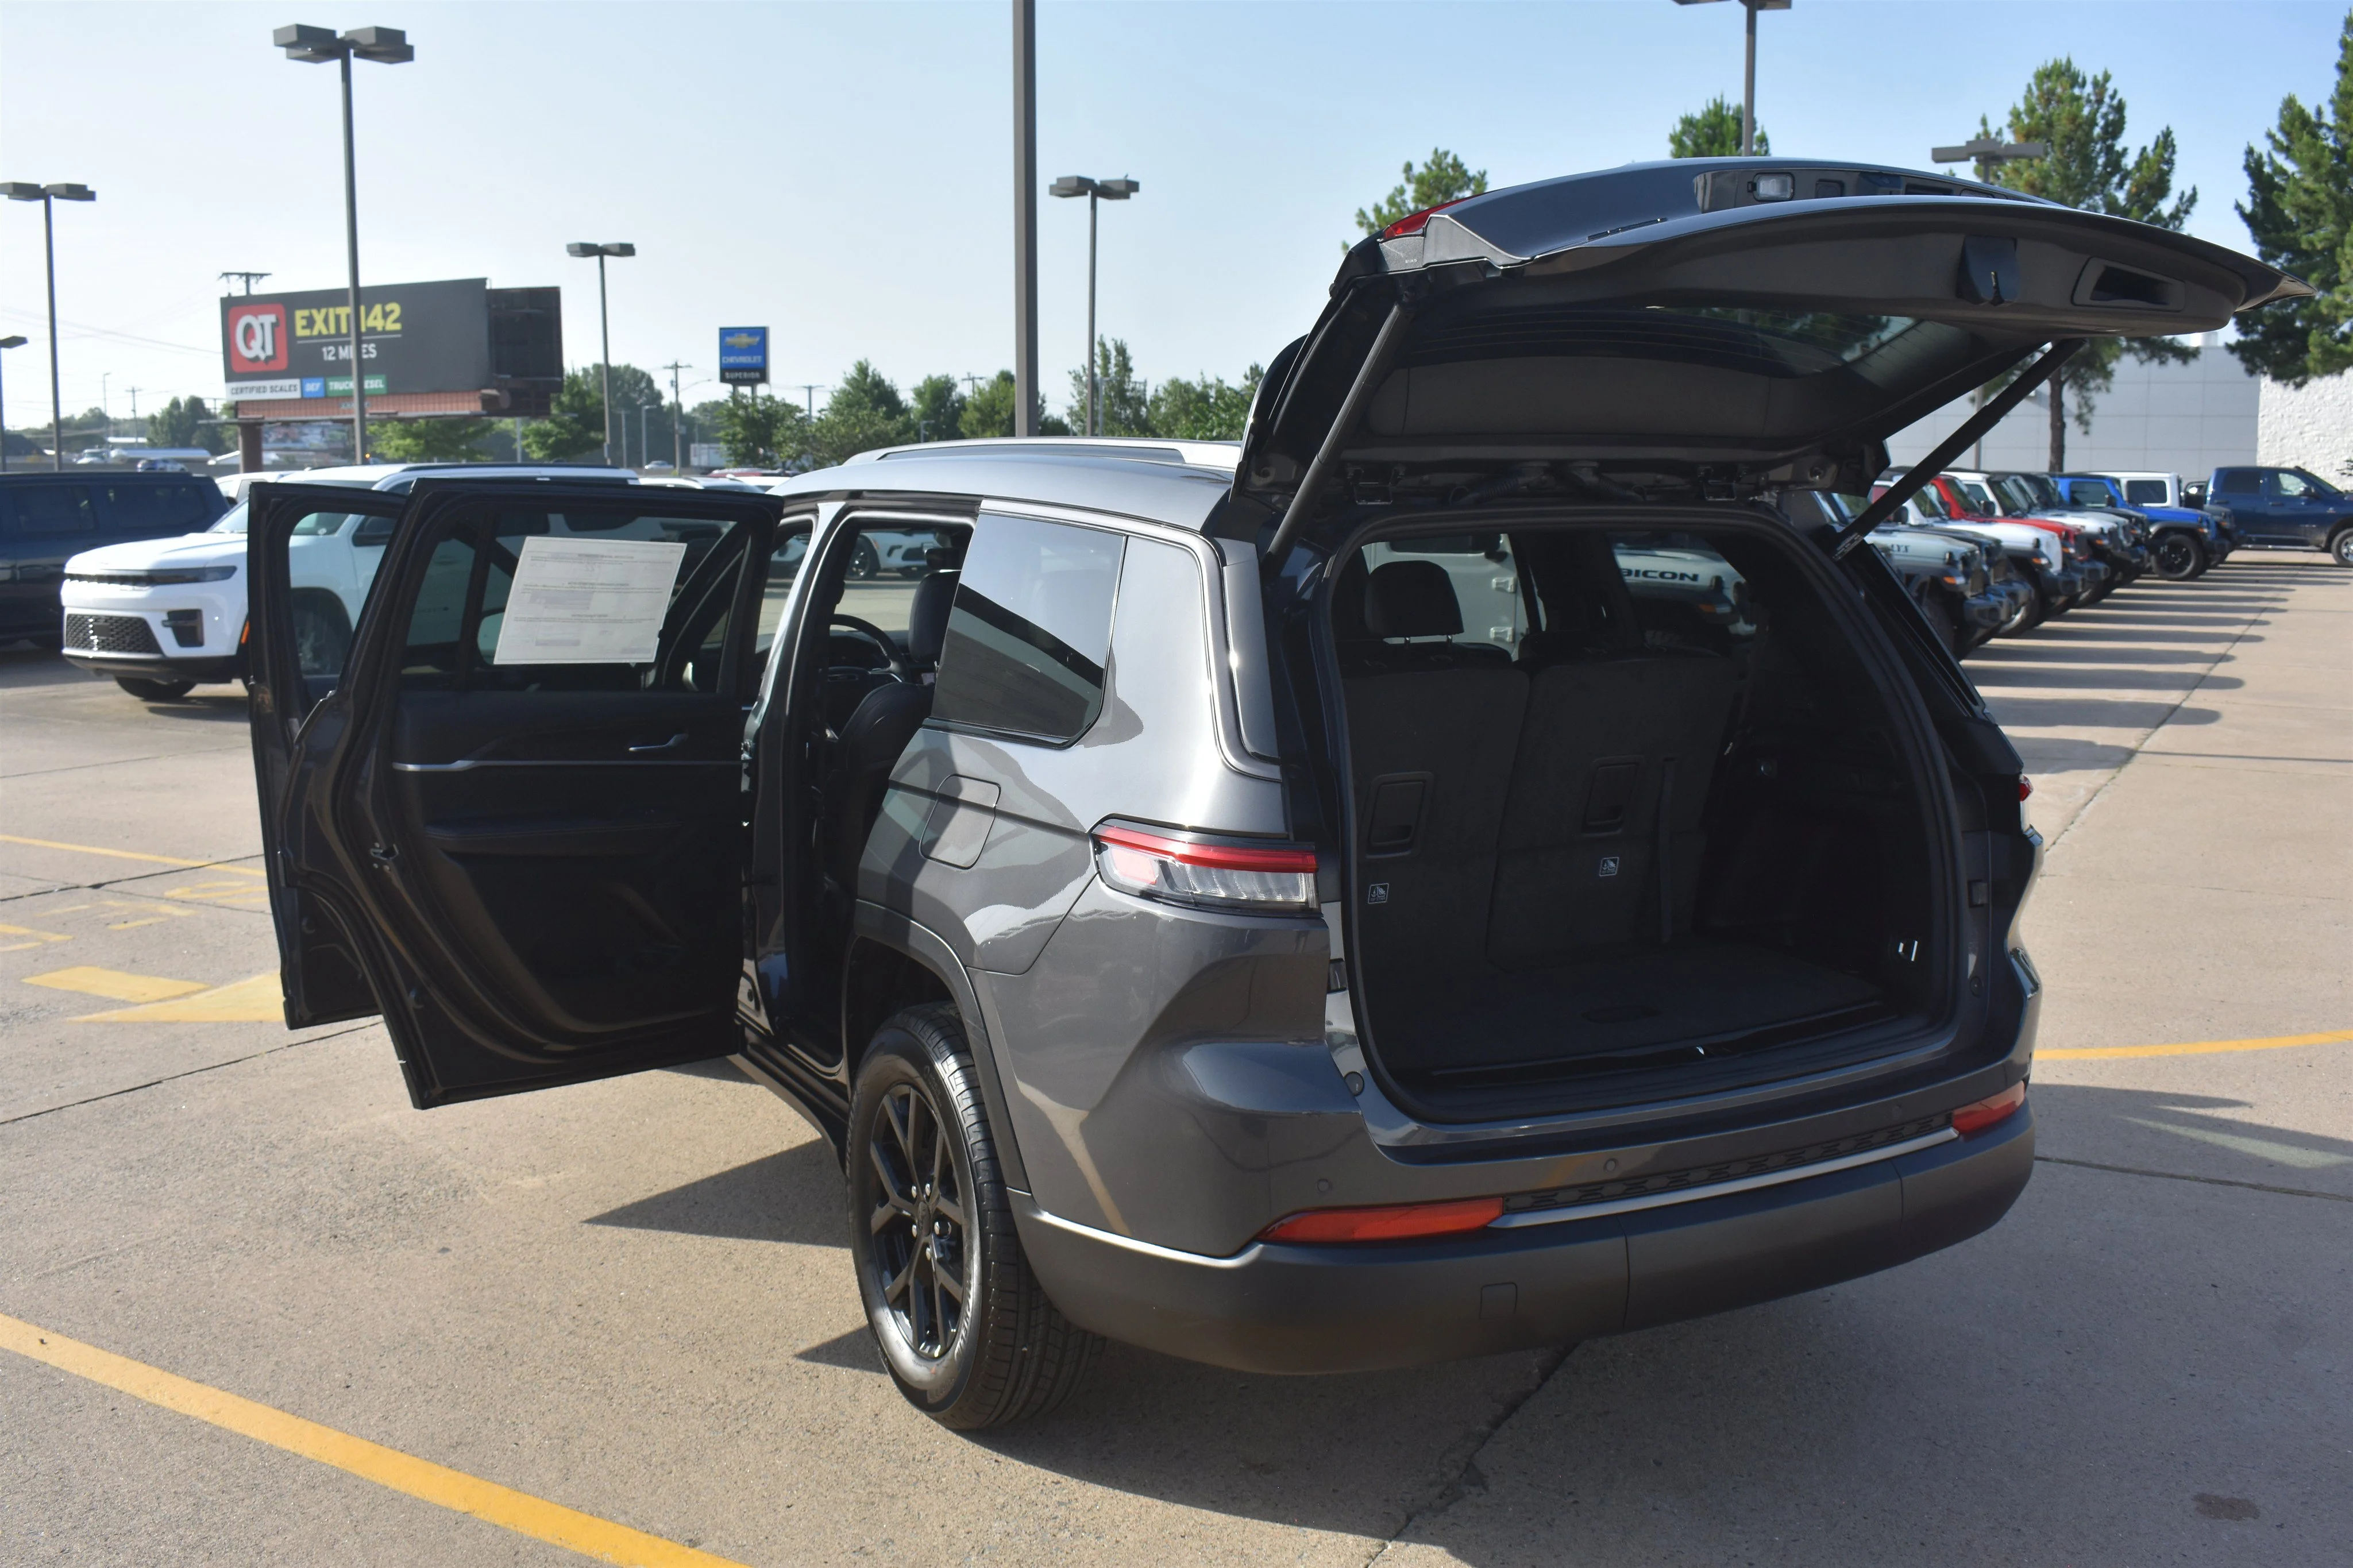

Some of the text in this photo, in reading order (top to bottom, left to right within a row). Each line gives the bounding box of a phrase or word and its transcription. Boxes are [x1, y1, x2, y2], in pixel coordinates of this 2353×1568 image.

[295, 302, 402, 337] EXIT 142
[236, 314, 277, 361] QT
[322, 343, 377, 361] 12 MIES
[231, 384, 298, 395] CERTIFIED SCALES
[364, 379, 384, 389] ESEL
[1620, 567, 1699, 582] BICON
